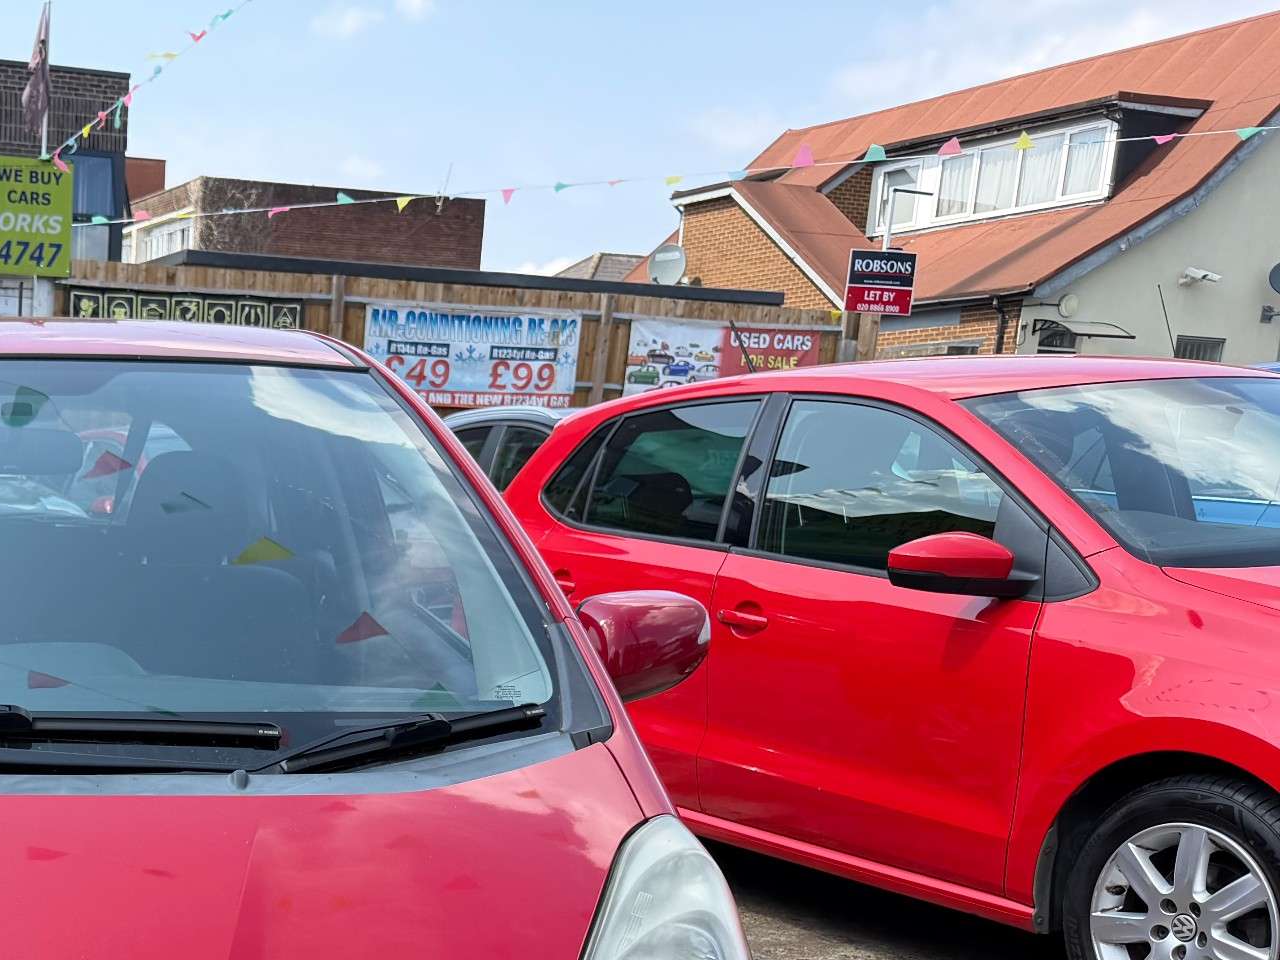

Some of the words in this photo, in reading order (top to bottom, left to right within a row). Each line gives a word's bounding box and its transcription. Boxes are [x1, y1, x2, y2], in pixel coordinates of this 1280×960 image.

[29, 171, 64, 186] BUY
[7, 190, 52, 206] CARS
[854, 259, 912, 274] ROBSONS
[864, 290, 882, 301] LET
[882, 291, 896, 302] BY
[730, 331, 770, 348] USED
[773, 334, 812, 350] CARS
[740, 353, 764, 368] FOR
[767, 355, 798, 369] SALE
[488, 360, 556, 391] £99
[453, 394, 475, 405] THE
[476, 394, 503, 406] NEW
